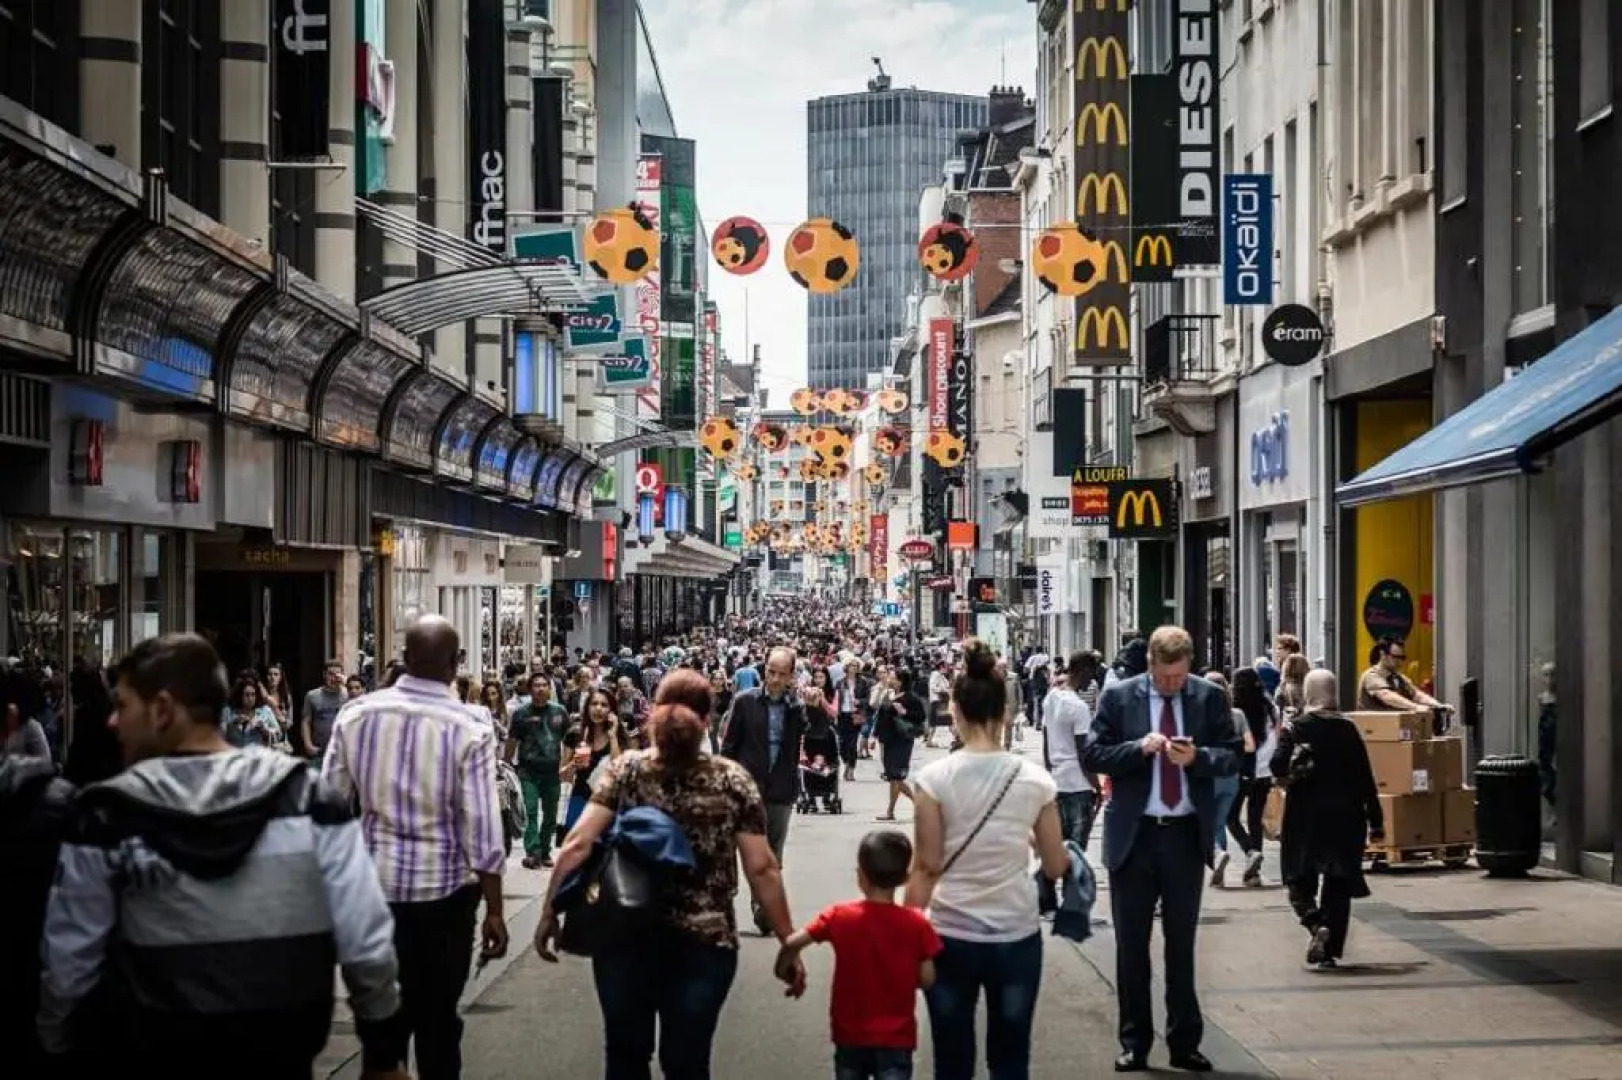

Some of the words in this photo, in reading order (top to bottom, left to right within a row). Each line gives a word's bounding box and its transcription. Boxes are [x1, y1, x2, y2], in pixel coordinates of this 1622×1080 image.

[474, 149, 504, 246] fnac
[1231, 182, 1260, 297] okaïdi
[1272, 321, 1322, 341] éram
[1073, 468, 1083, 482] A
